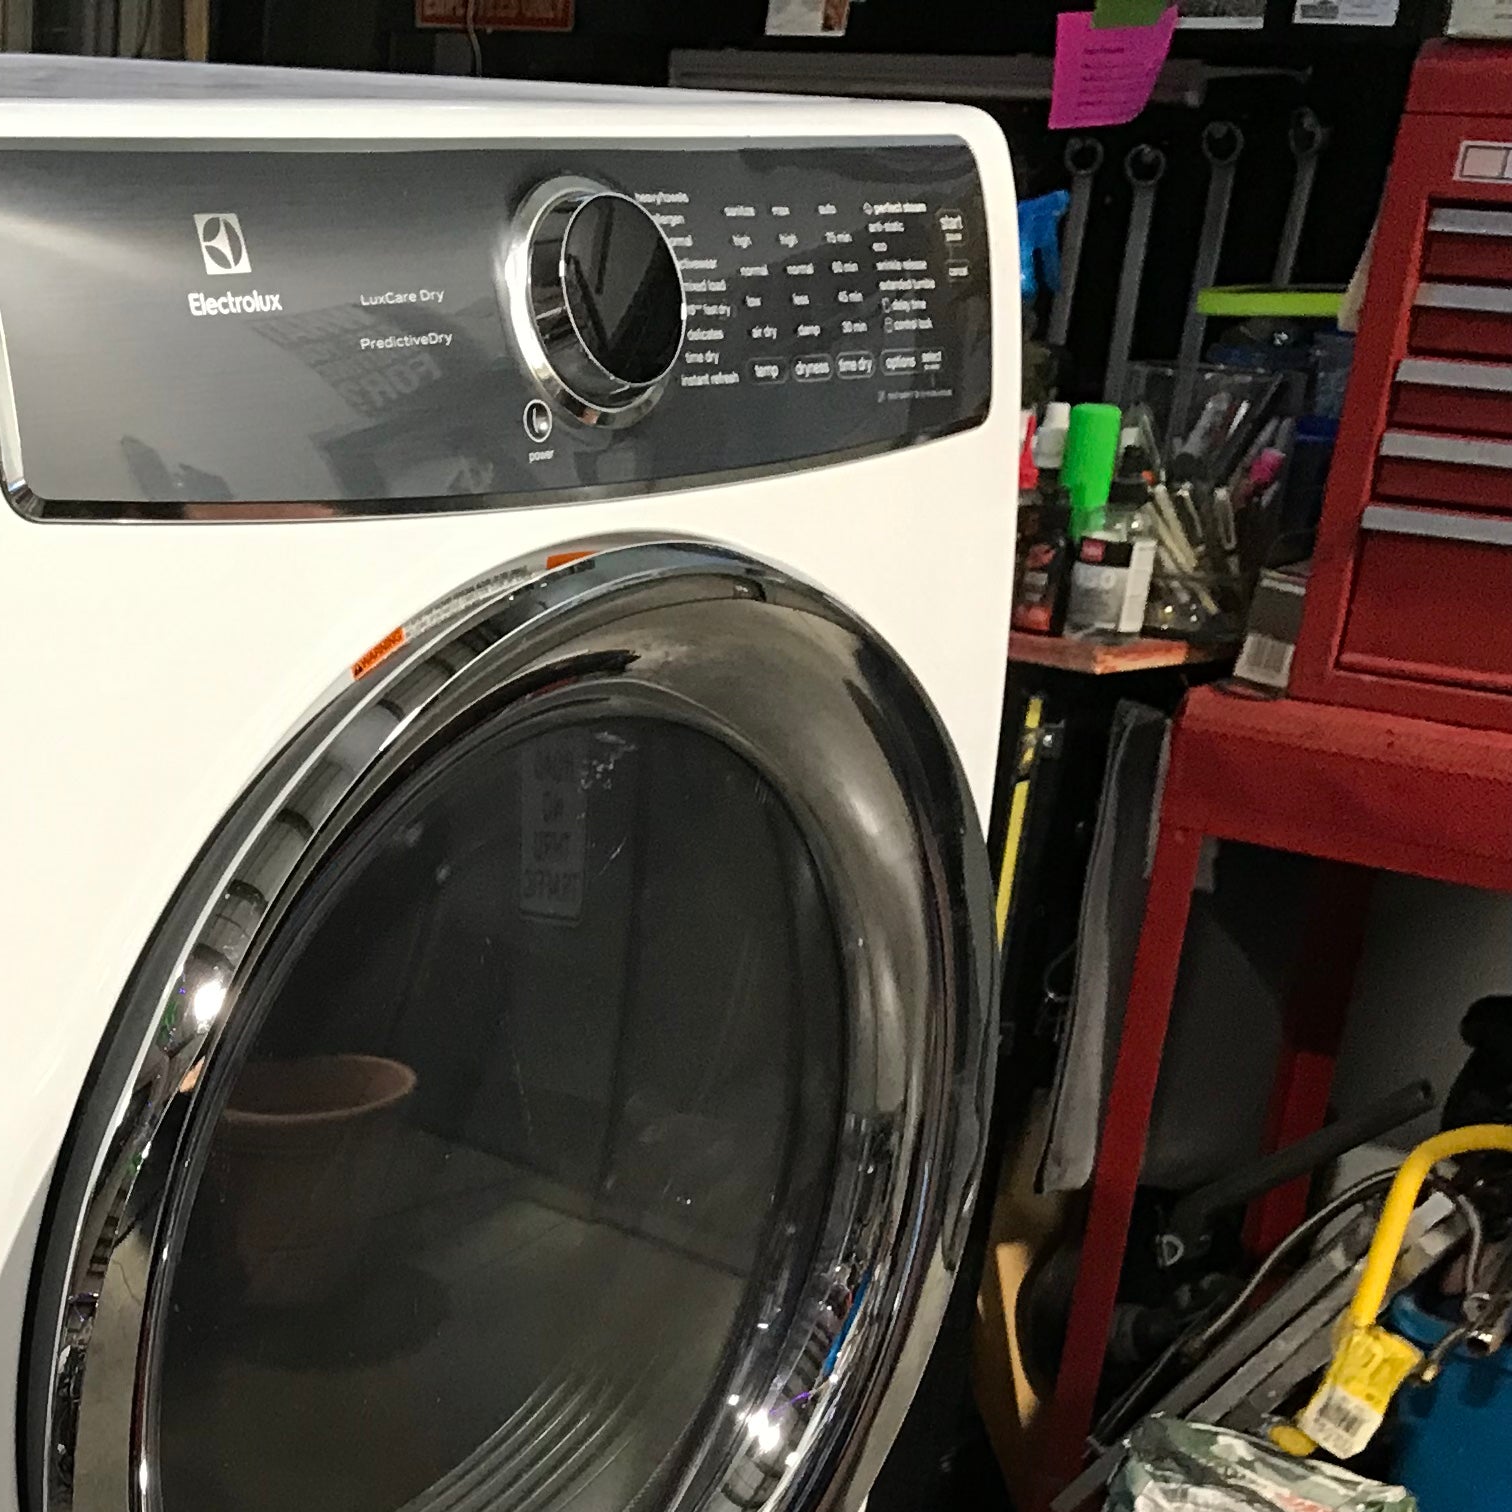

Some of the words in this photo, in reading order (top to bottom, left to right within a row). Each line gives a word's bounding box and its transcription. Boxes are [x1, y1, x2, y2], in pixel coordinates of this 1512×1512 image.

[188, 289, 283, 316] Electrolux
[360, 290, 417, 306] LuxCare
[419, 289, 445, 304] Dry
[360, 331, 453, 350] PredictiveDry
[529, 449, 555, 464] power
